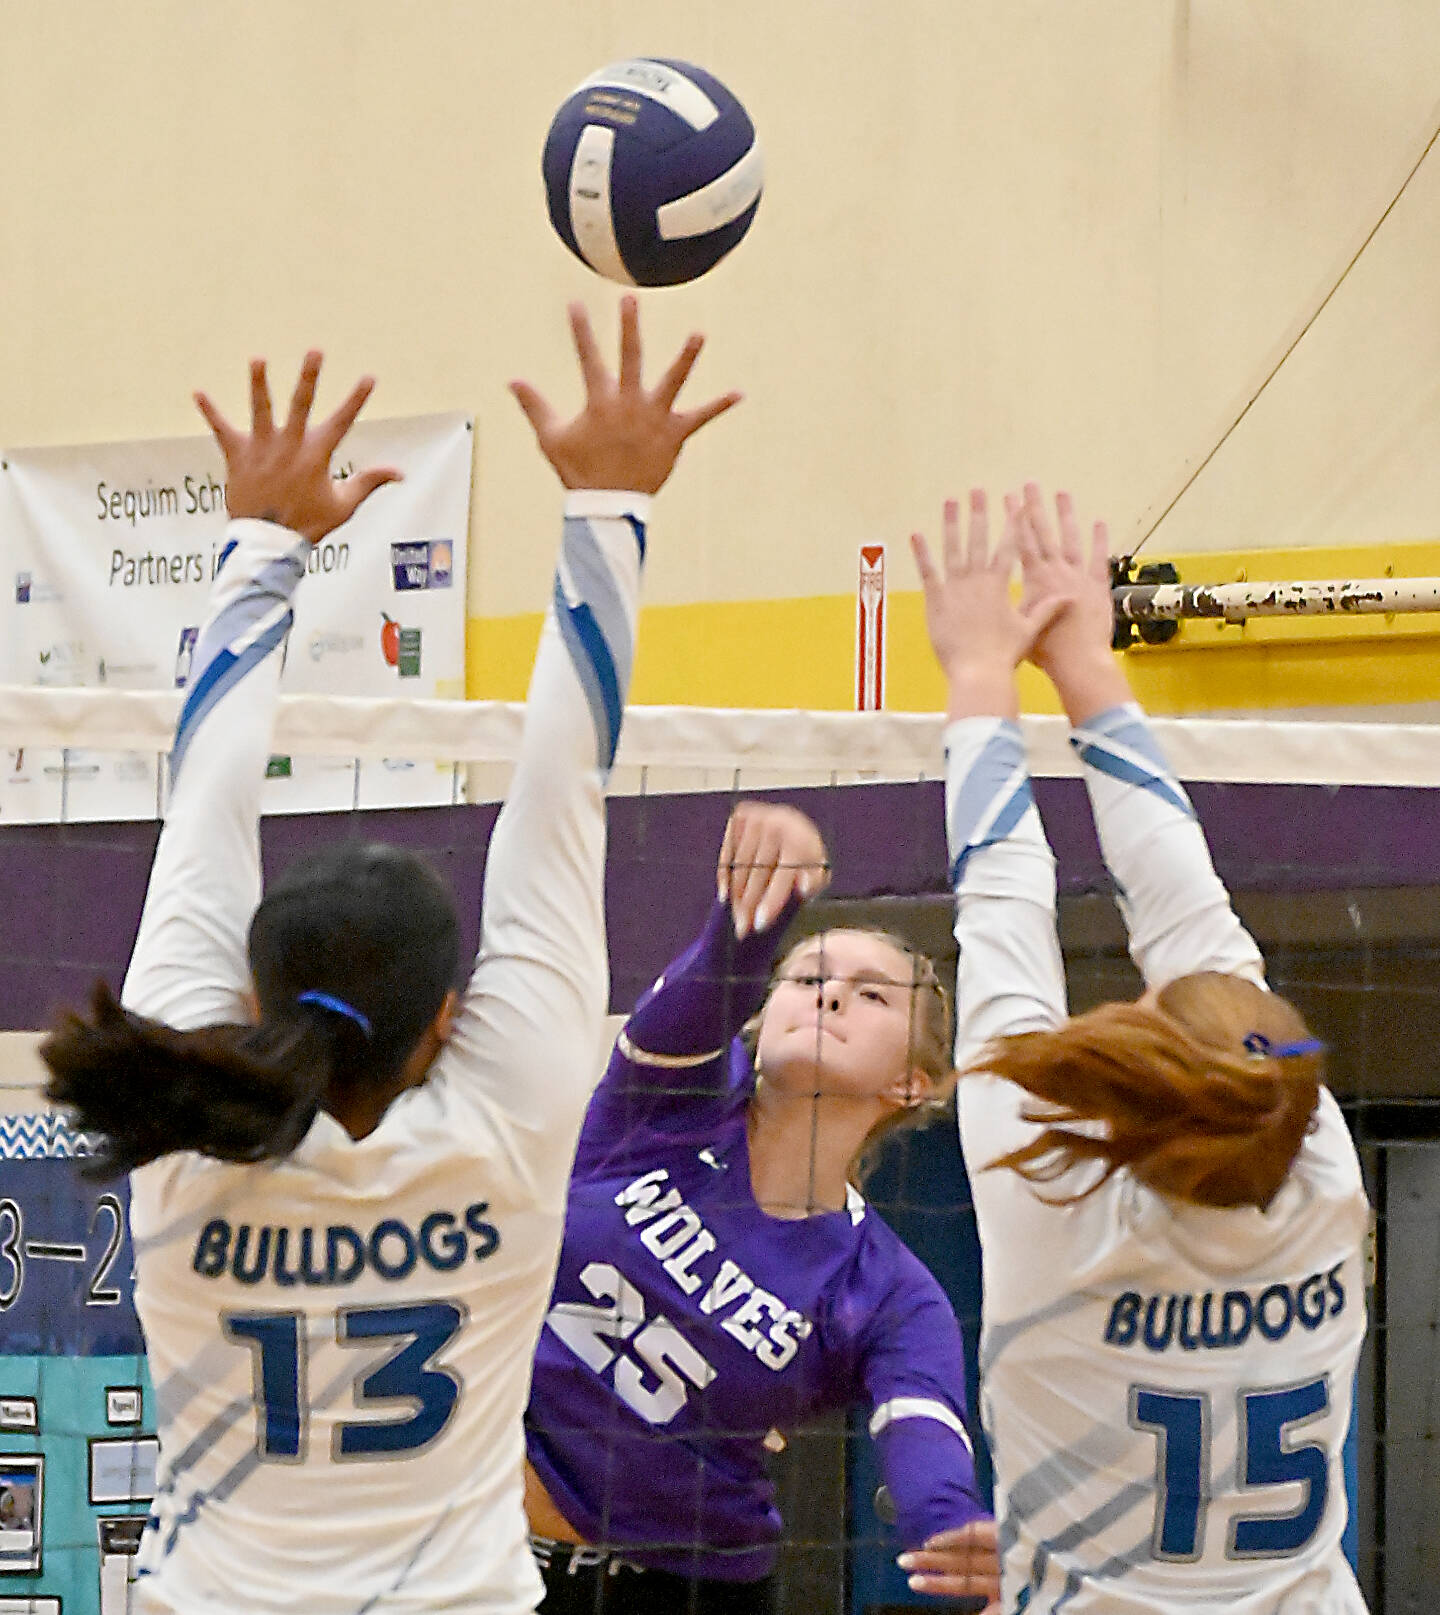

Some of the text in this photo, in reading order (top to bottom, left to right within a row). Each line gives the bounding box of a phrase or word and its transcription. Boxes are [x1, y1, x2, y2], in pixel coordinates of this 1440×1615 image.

[97, 472, 224, 528] Sequim Sch
[109, 549, 203, 586] Partners
[193, 1202, 501, 1287] BULLDOGS
[613, 1168, 813, 1372] WOLVES
[1103, 1260, 1346, 1352] BULLDOGS
[219, 1299, 471, 1465] 13
[545, 1261, 718, 1425] 25
[1126, 1371, 1332, 1564] 15
